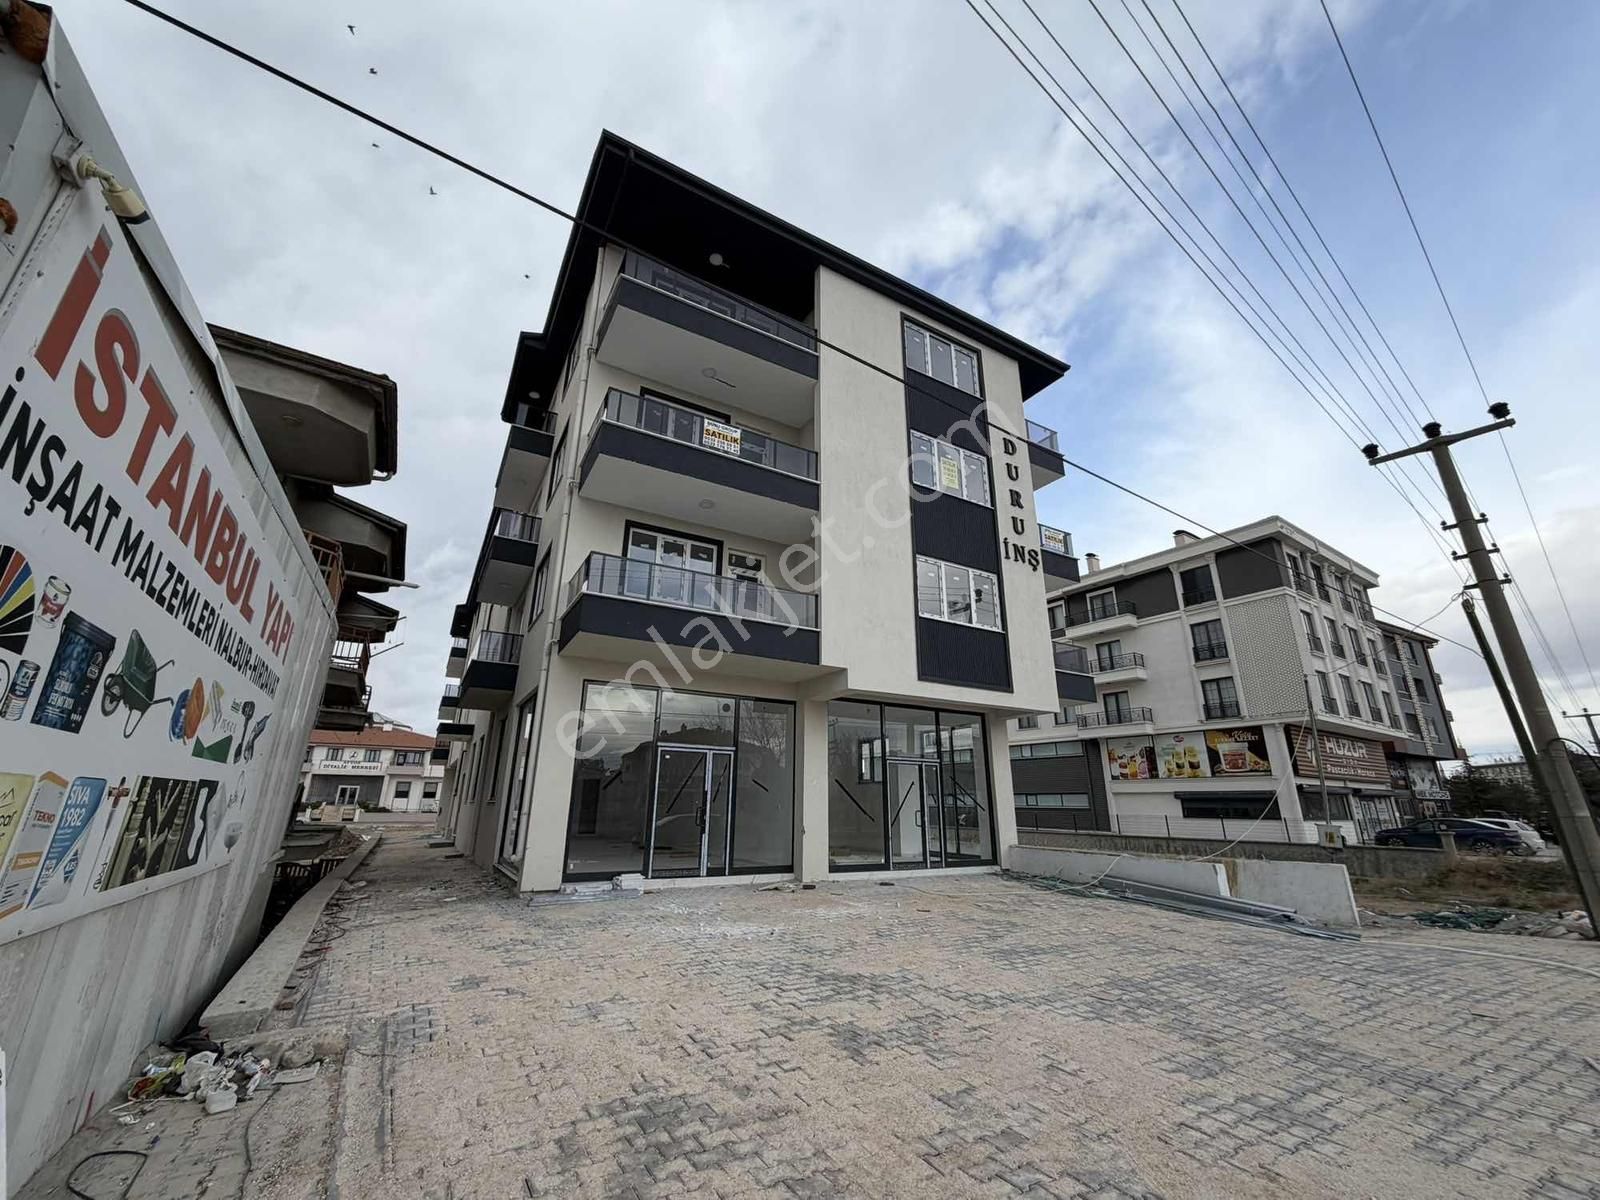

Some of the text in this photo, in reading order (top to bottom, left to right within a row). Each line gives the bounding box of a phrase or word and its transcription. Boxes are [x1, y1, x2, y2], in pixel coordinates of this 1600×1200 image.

[34, 224, 295, 667] İSTANBUL YAPI
[704, 428, 739, 445] SATILIK
[0, 366, 122, 552] İNŞAAT
[111, 516, 224, 648] MALZEMLERİ
[1003, 537, 1041, 572] İNŞ
[1324, 736, 1369, 759] HUZUR
[61, 808, 86, 826] 1982
